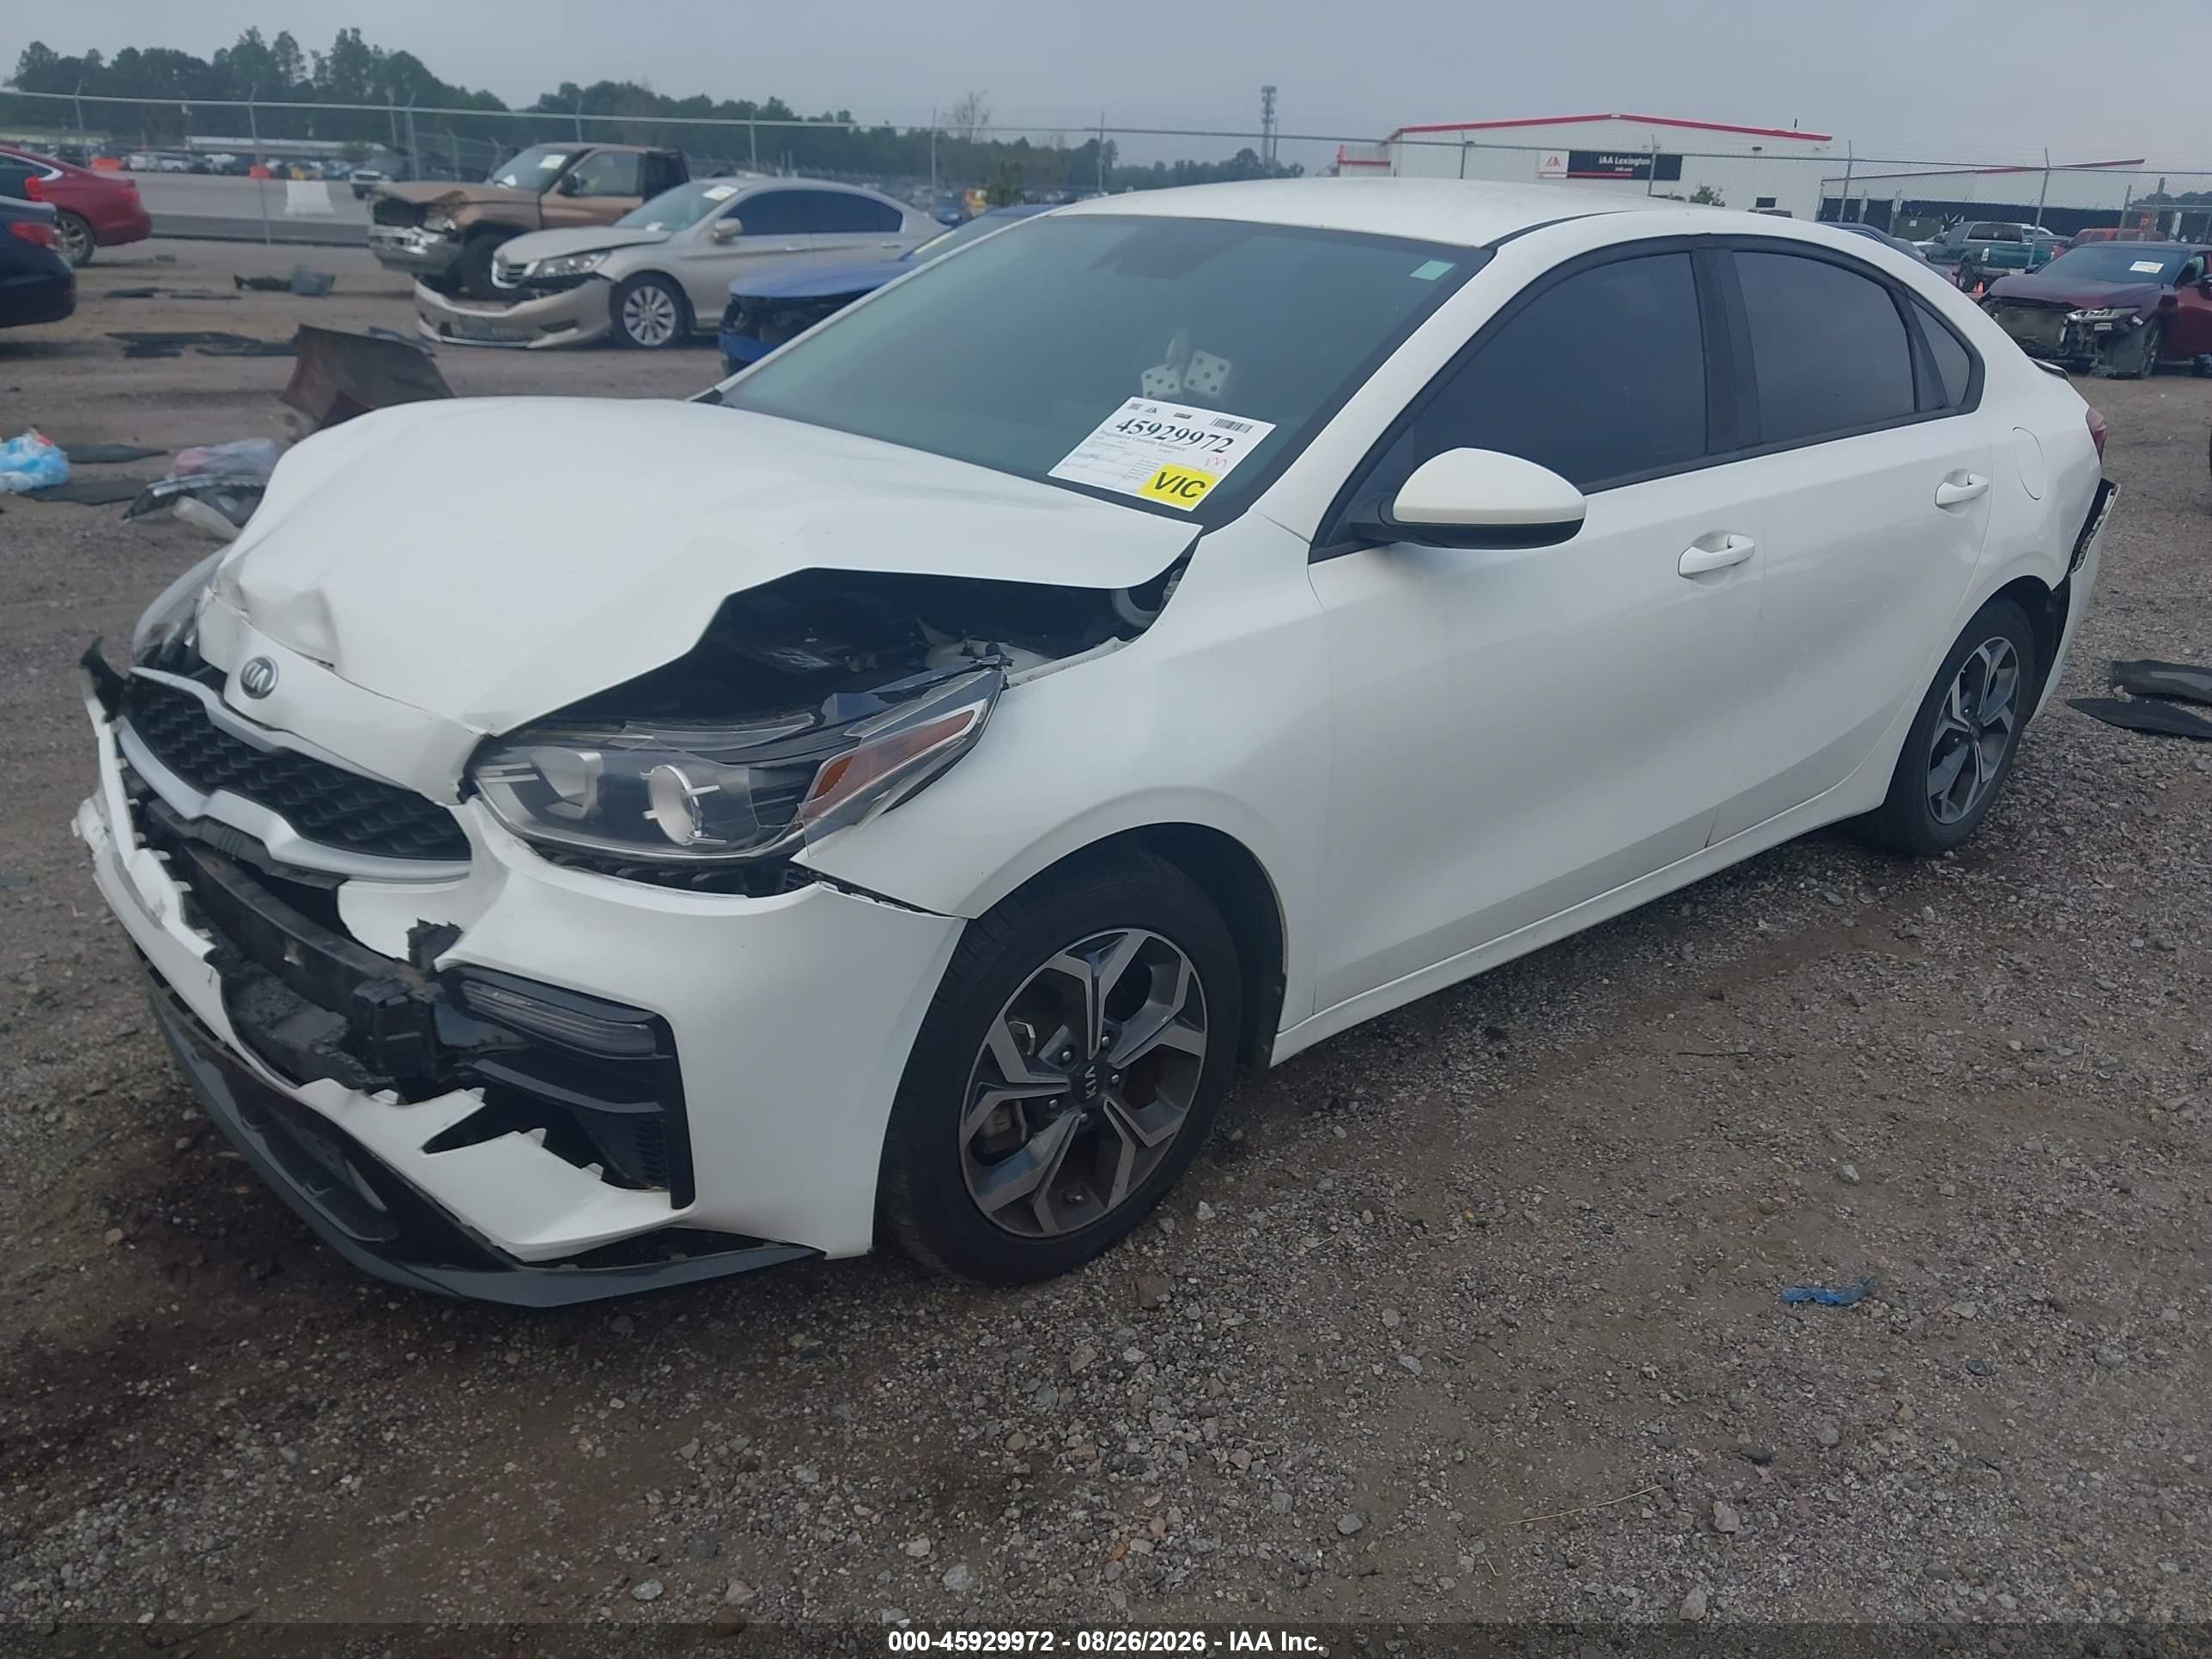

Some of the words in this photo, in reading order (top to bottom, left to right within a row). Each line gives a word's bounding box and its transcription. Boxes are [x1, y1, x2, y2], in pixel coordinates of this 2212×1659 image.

[1614, 156, 1651, 167] Lexington
[1115, 417, 1235, 454] 45929972
[1153, 471, 1206, 498] VIC
